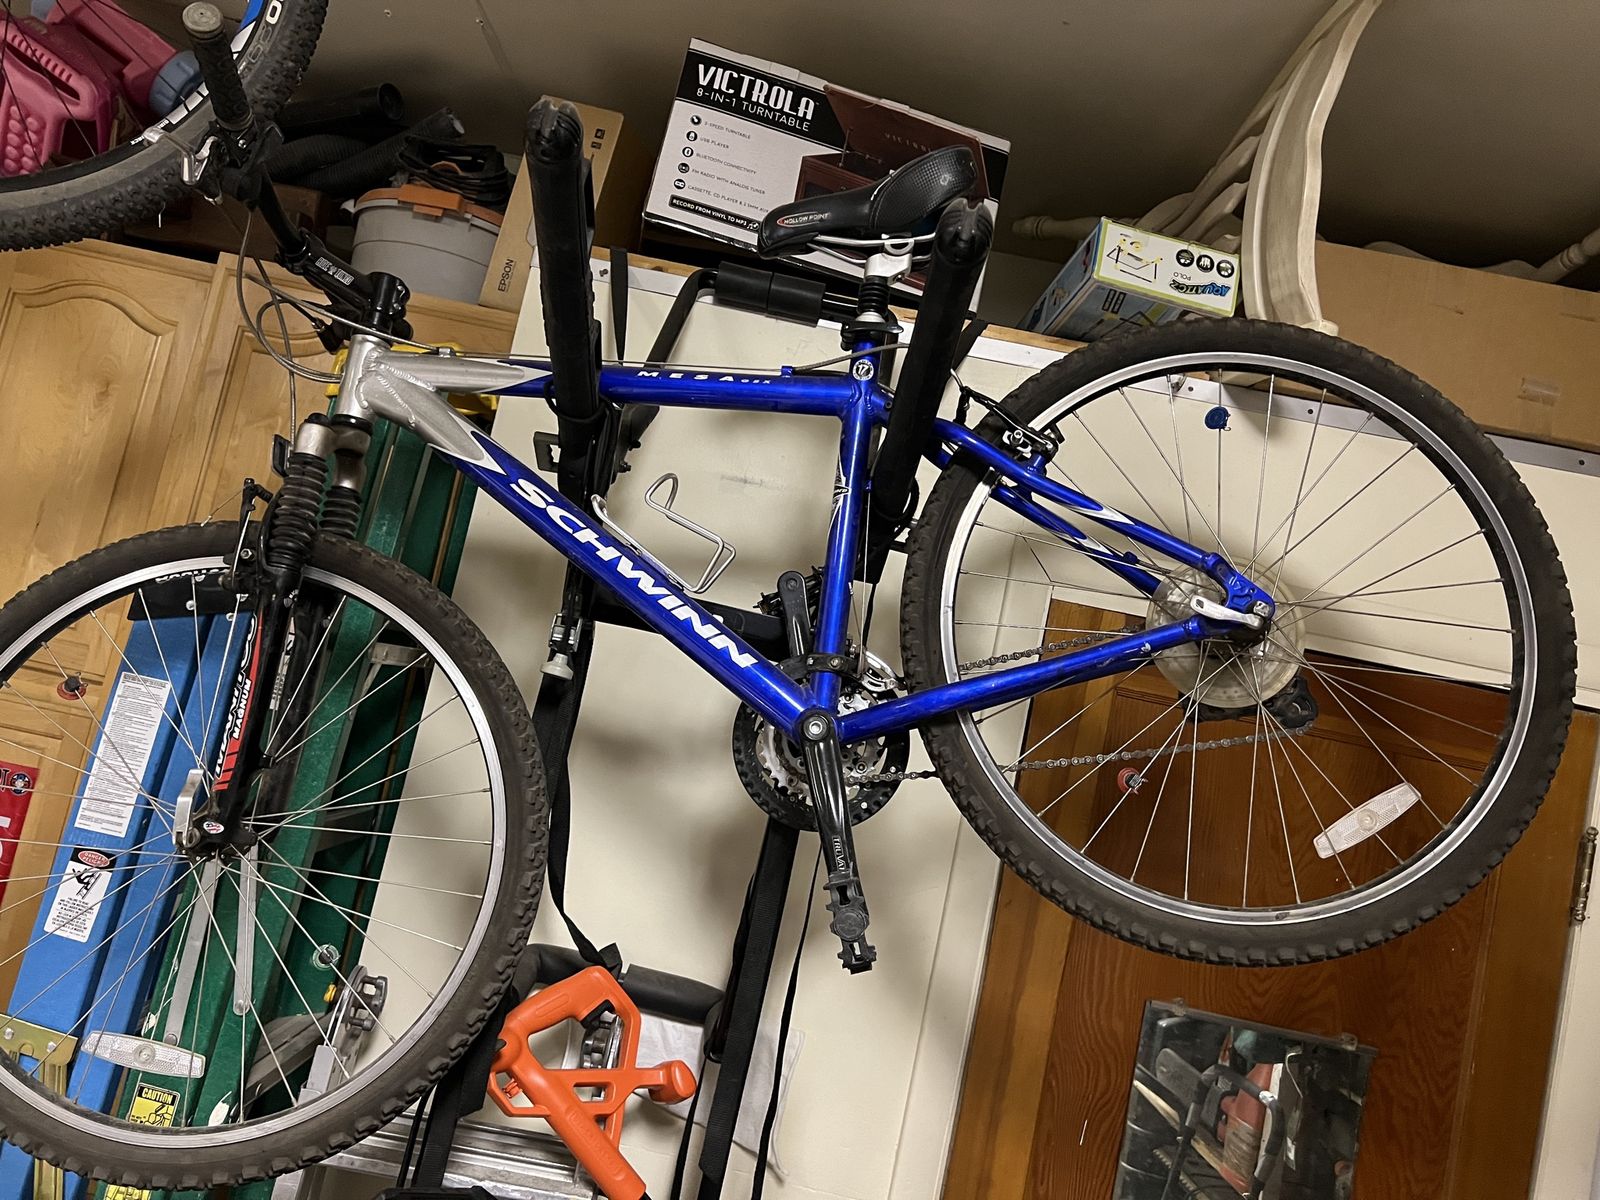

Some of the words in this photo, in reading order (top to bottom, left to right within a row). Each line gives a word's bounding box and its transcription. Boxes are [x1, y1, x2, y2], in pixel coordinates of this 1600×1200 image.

[698, 63, 815, 120] VICTROLA
[696, 87, 736, 107] 8-IN-1
[742, 101, 811, 132] TURNTABLE
[725, 127, 751, 139] TURNTABLE
[711, 140, 729, 149] PLAYER
[696, 153, 723, 164] BLUETOOTH
[723, 161, 757, 175] CONNECTIVITY
[700, 170, 715, 179] RADIO
[730, 180, 749, 190] ANALOG
[750, 186, 765, 195] TUNER
[721, 195, 738, 203] PLAYER
[672, 199, 695, 210] RECORD
[695, 205, 712, 215] FROM
[712, 211, 727, 220] VINYL
[727, 215, 735, 223] TO
[735, 218, 747, 227] MP3
[784, 215, 808, 225] HOLLOW
[808, 212, 828, 221] POINT
[497, 258, 514, 292] EPSON
[1173, 271, 1191, 281] POLO
[637, 370, 735, 382] MESA
[858, 363, 869, 375] 17
[510, 478, 758, 668] SCHWINN
[232, 678, 252, 739] MAGNUM
[142, 1087, 173, 1105] CAUTION
